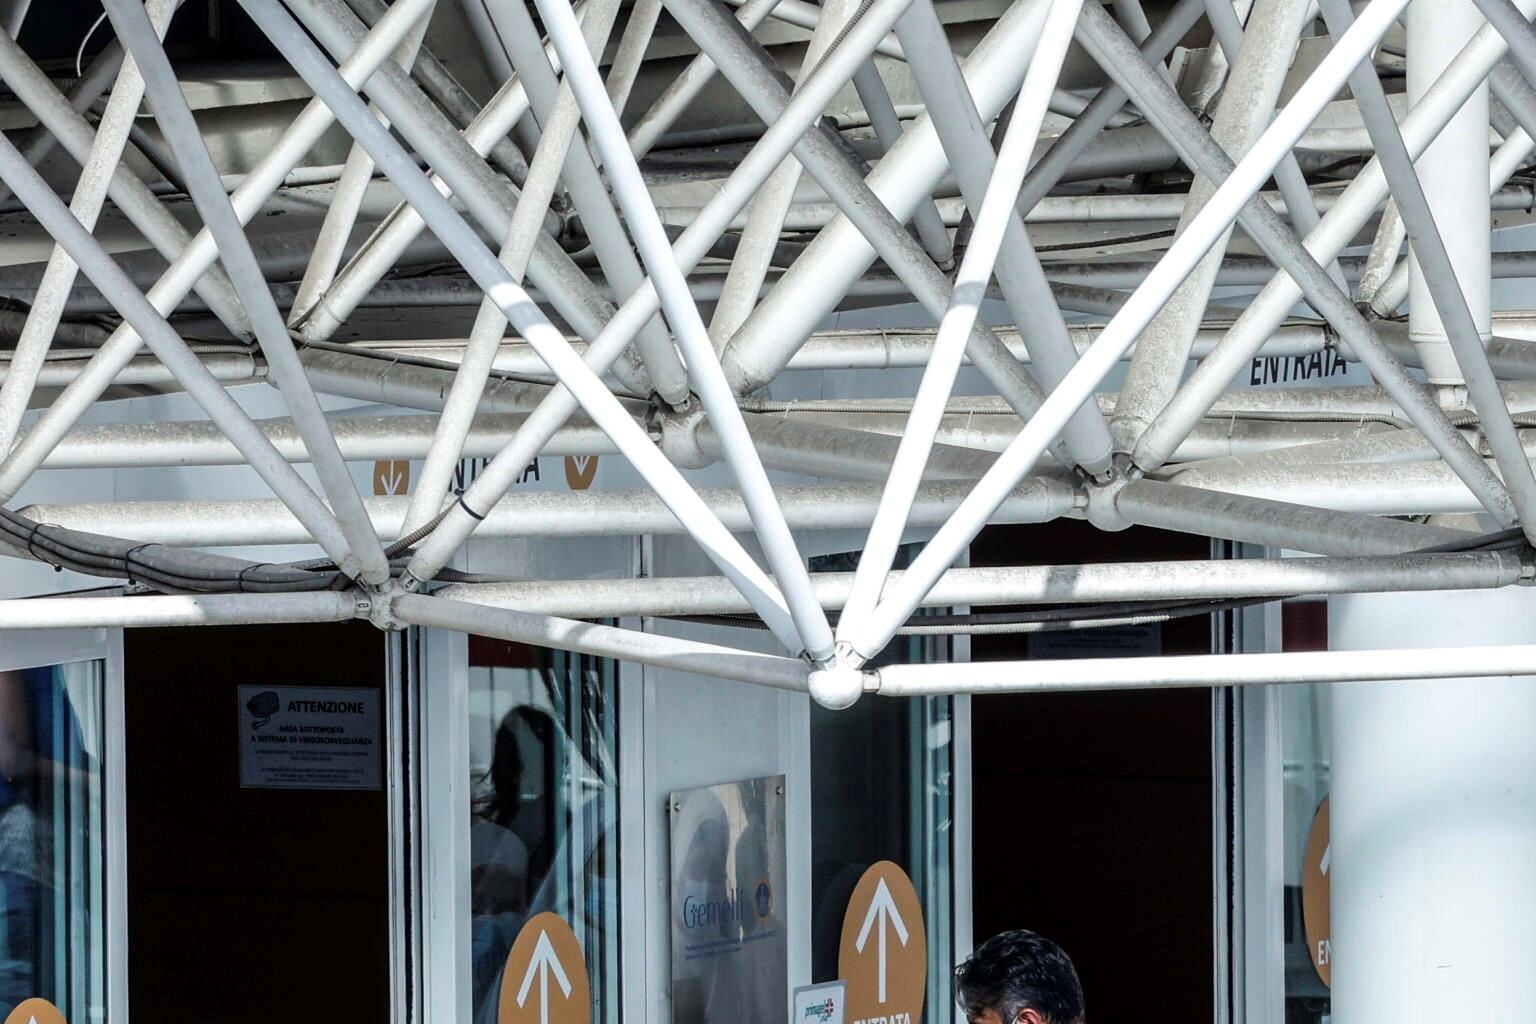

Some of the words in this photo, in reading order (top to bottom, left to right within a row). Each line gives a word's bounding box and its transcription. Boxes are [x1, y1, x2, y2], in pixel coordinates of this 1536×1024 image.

[287, 700, 365, 714] ATTENZIONE
[279, 725, 298, 733] AREA
[257, 735, 288, 743] SISTEMA
[683, 887, 744, 929] Gemelli
